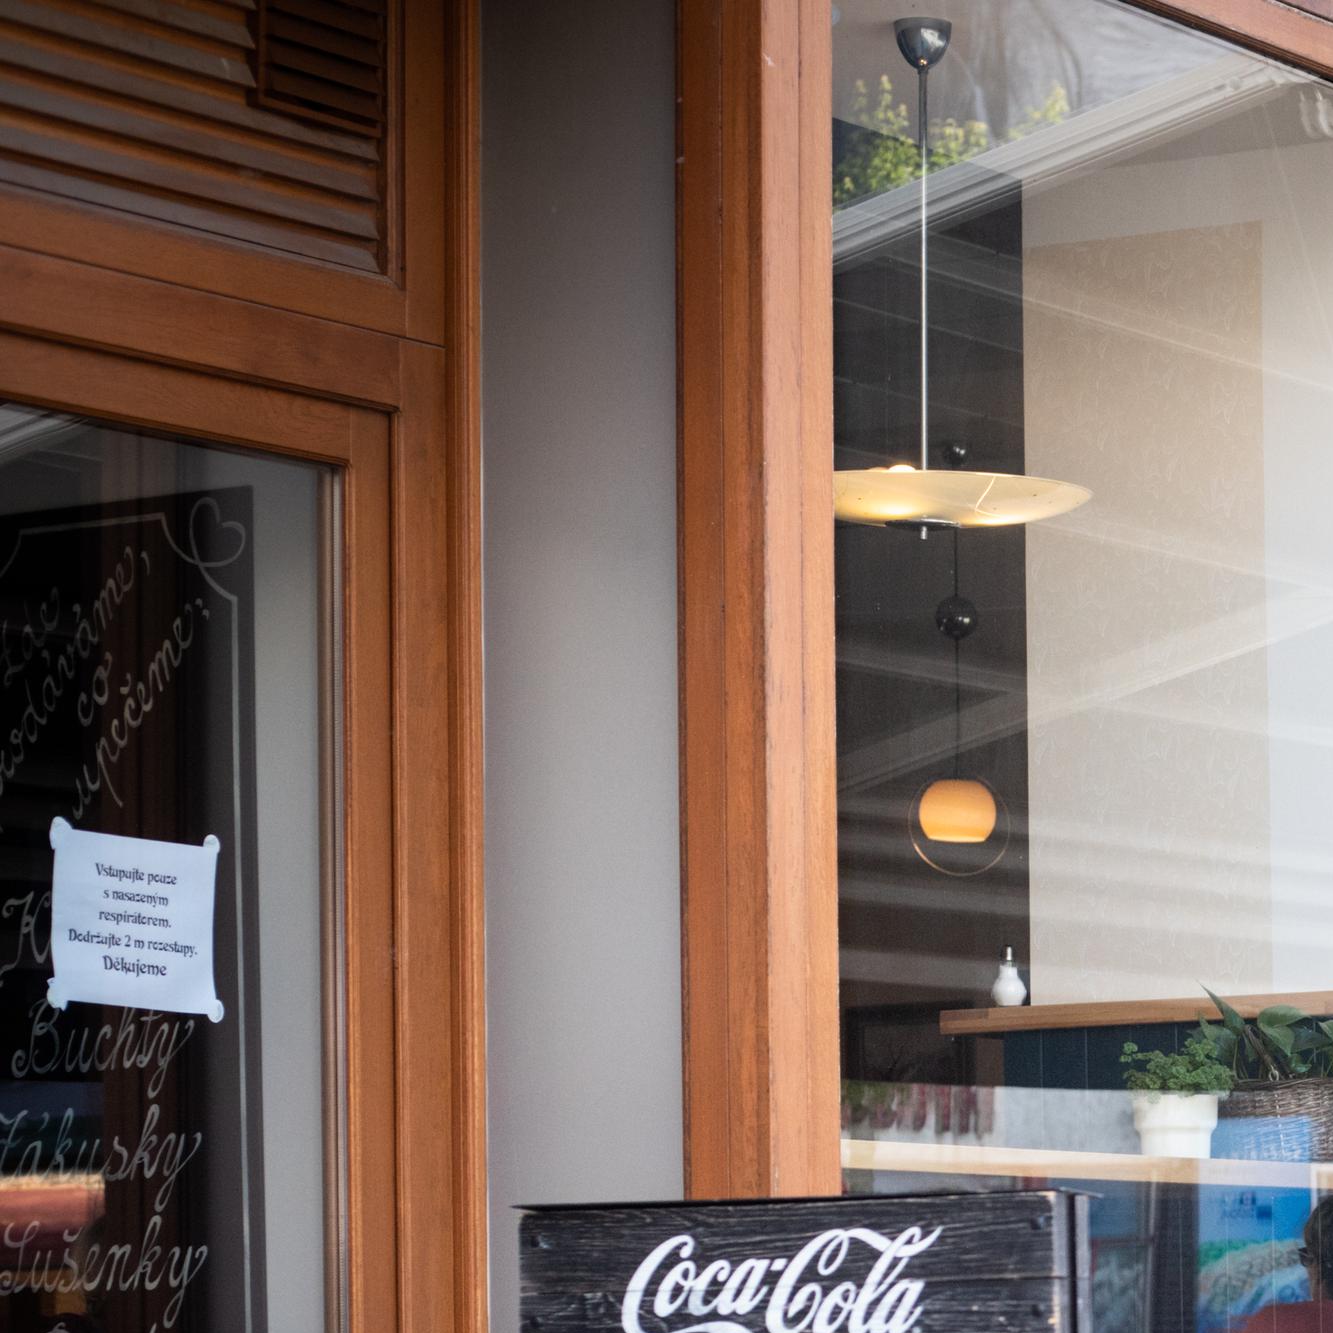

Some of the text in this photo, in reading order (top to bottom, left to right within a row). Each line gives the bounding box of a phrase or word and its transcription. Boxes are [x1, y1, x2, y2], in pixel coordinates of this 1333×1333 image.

[95, 863, 177, 886] Vstupujte pouze
[103, 889, 169, 908] s nasazeným
[98, 909, 172, 929] respirátorem.
[68, 928, 198, 958] Dodržujte 2 m rozestupy.
[102, 954, 167, 978] Děkujeme
